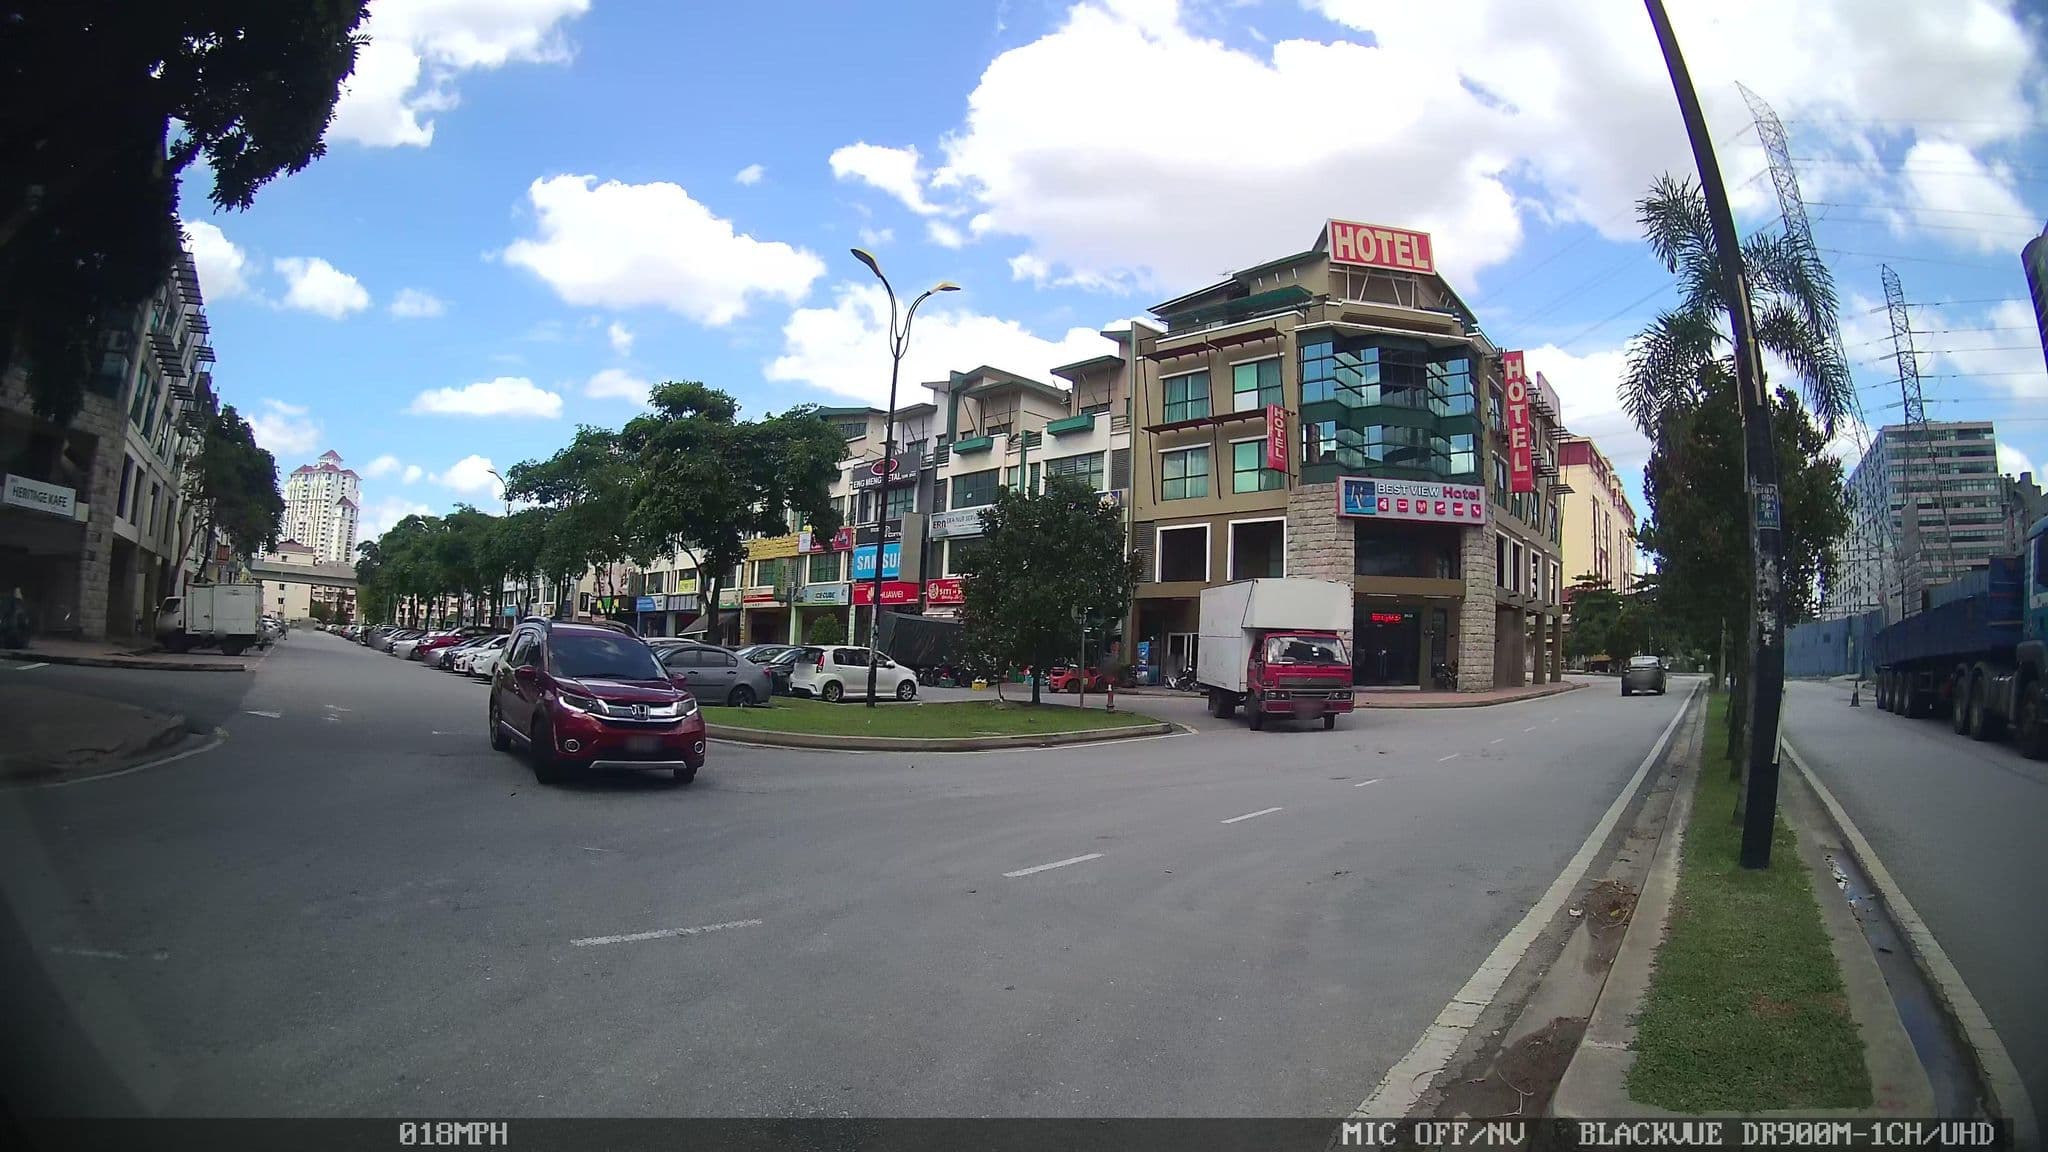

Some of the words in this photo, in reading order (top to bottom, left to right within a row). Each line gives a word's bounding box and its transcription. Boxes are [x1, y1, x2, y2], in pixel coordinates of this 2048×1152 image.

[1334, 224, 1430, 270] HOTEL
[1273, 406, 1285, 460] HOTEL
[1506, 359, 1528, 473] HOTEL
[12, 485, 48, 504] HERITAGE
[48, 493, 68, 508] KAFE
[1377, 483, 1408, 495] BEST
[1410, 486, 1439, 497] VIEW
[1442, 486, 1480, 501] Hotel
